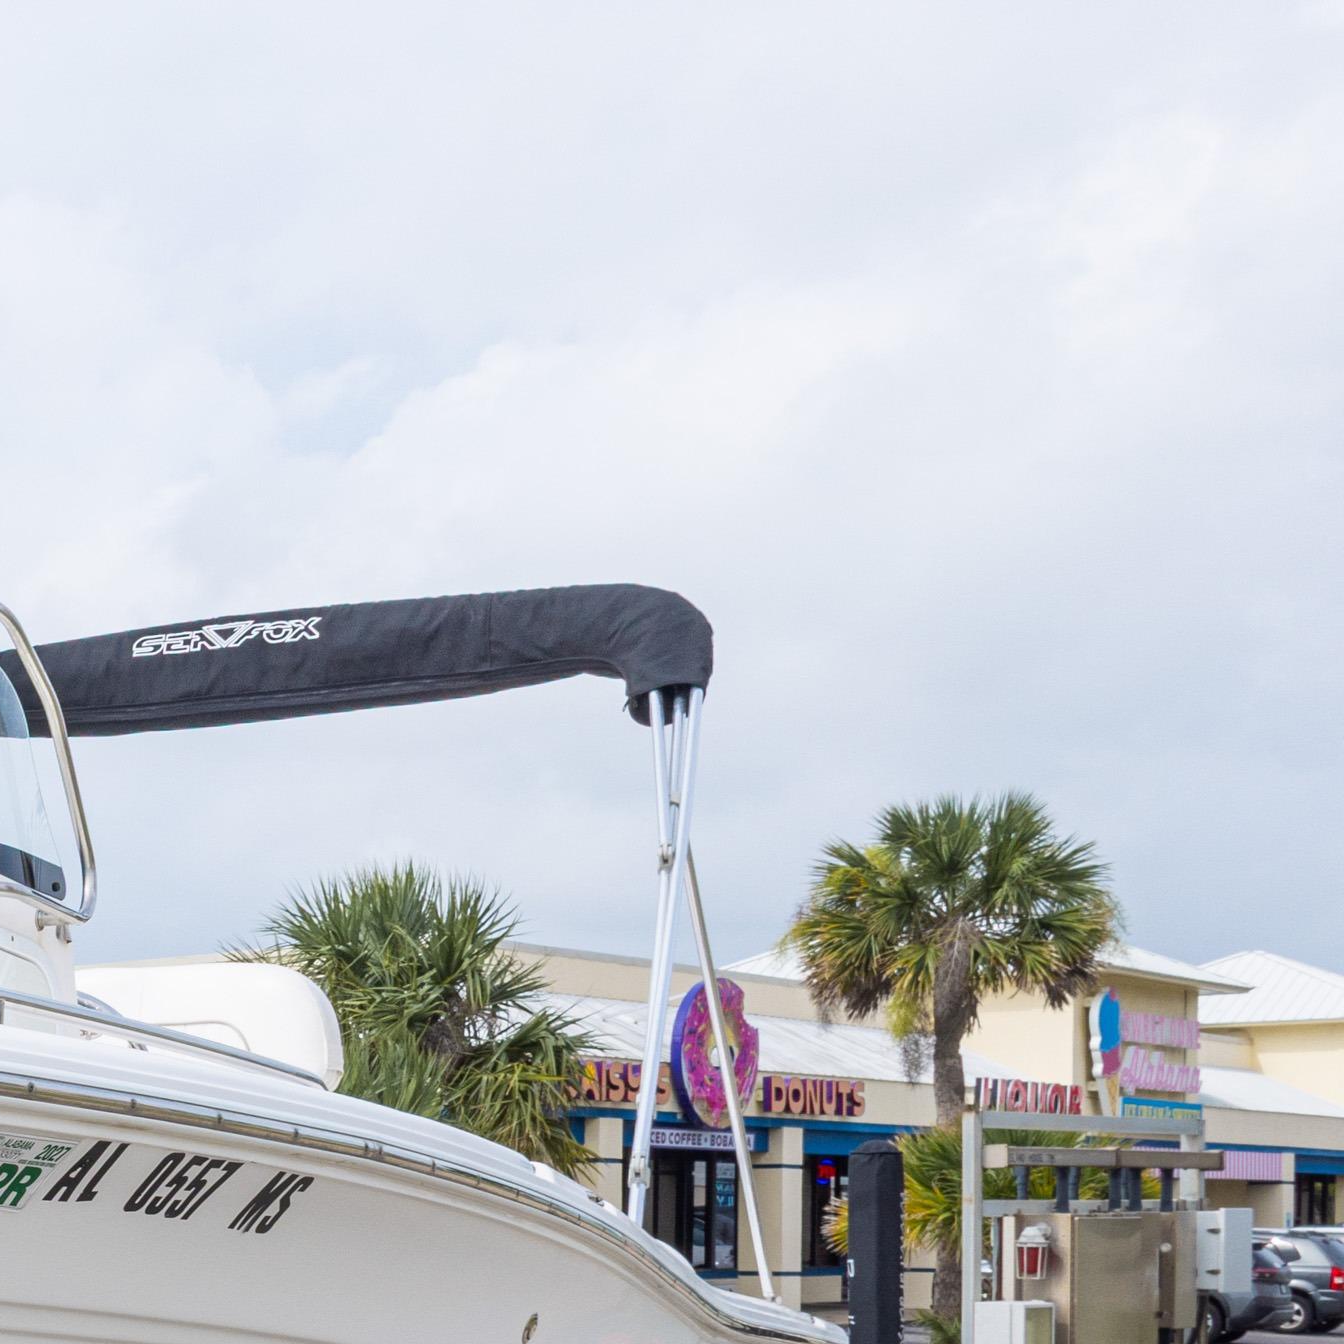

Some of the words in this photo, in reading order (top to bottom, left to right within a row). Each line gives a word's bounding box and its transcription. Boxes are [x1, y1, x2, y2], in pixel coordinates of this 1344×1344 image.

[763, 1074, 866, 1118] DONUTS
[34, 1144, 72, 1163] 2027
[650, 1130, 666, 1144] CED
[668, 1131, 703, 1146] COFFEE
[709, 1134, 734, 1148] BOBA
[43, 1140, 130, 1202] AL
[123, 1152, 245, 1220] 0557
[228, 1170, 315, 1234] MS
